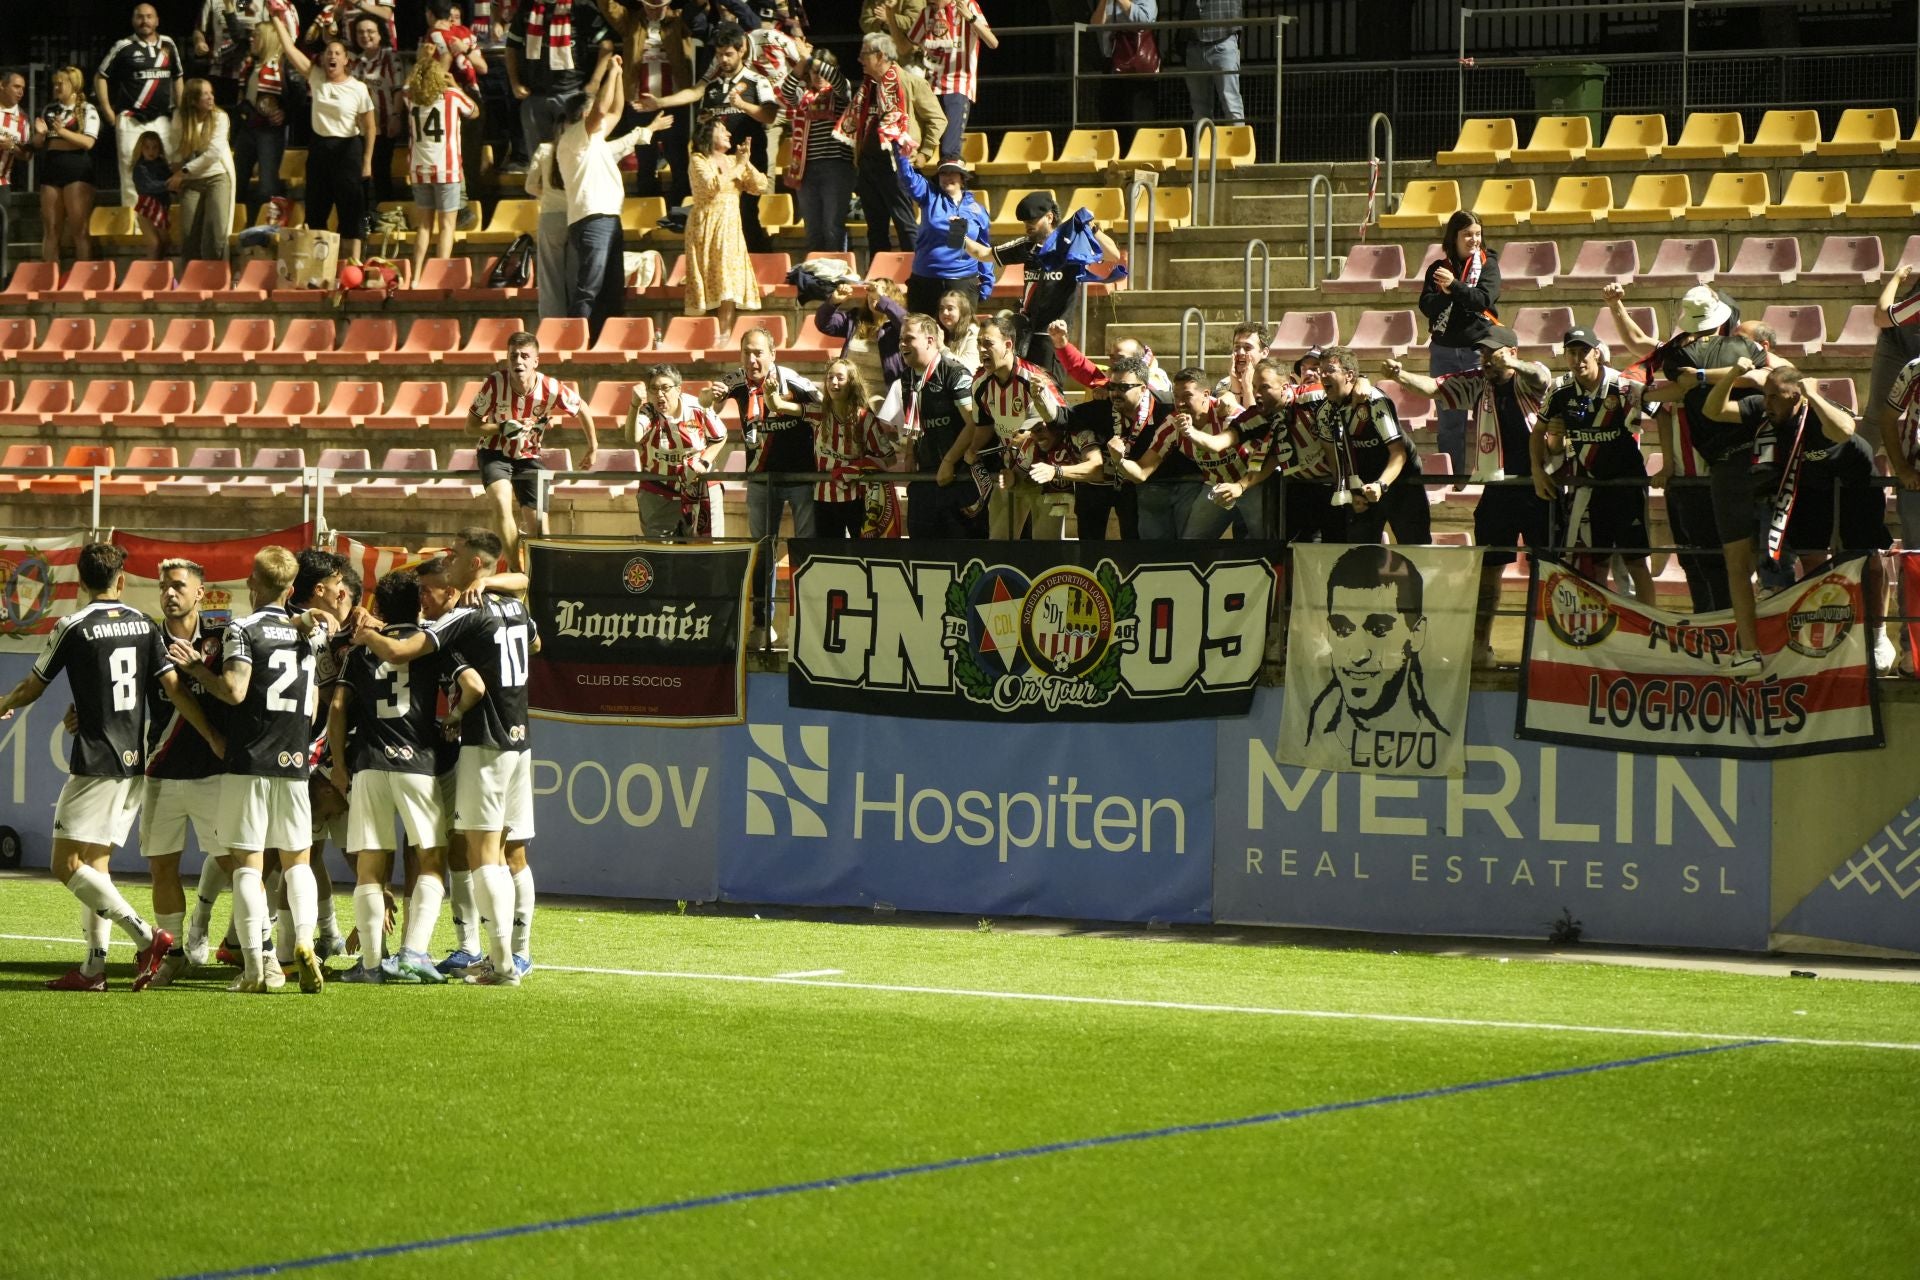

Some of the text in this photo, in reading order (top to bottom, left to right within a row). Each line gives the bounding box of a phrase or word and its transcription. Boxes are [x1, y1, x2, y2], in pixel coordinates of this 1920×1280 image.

[411, 107, 444, 142] 14
[1024, 270, 1063, 280] 3BLNCO
[1023, 584, 1046, 625] SOCIEDAD
[1048, 574, 1089, 589] DEPORTIVA
[1043, 595, 1065, 634] SDL
[83, 621, 150, 641] LAMADRID
[555, 601, 712, 647] Logroñés
[794, 557, 1275, 697] GN 09
[951, 620, 967, 637] 19
[1114, 625, 1131, 639] 40
[1648, 619, 1743, 664] AÚP
[494, 625, 529, 687] 10
[109, 647, 137, 712] 8
[266, 649, 317, 717] 21
[375, 661, 411, 718] 3
[576, 674, 682, 688] CLUB DE SOCIOS
[994, 674, 1098, 707] On Tour
[1351, 729, 1437, 770] LEDO
[1247, 739, 1738, 848] MERLIN
[853, 772, 1186, 863] Hospiten
[1246, 848, 1737, 894] REAL ESTATES SL
